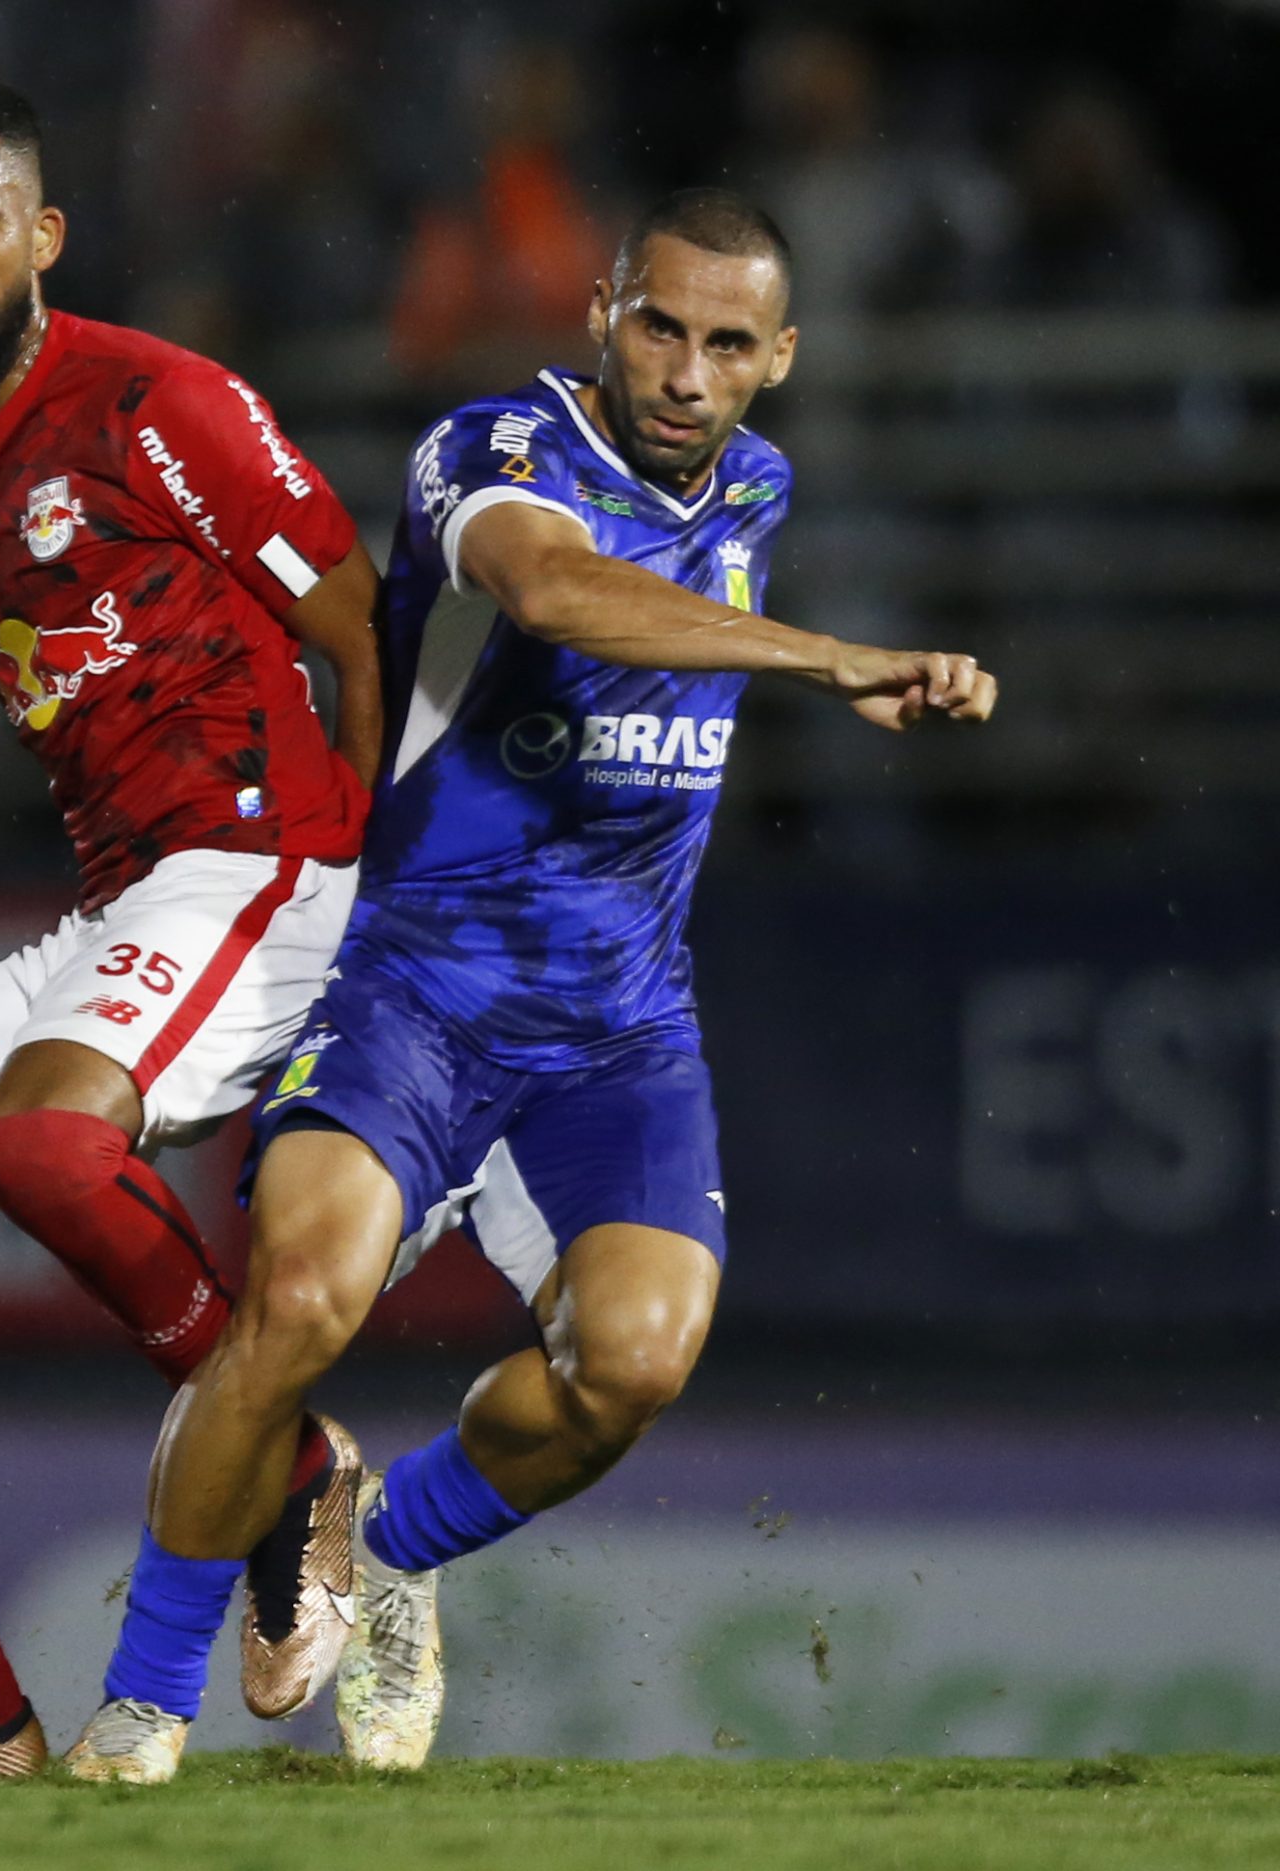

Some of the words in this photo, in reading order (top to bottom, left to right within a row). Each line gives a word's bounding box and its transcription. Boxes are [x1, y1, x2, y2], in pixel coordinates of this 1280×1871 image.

[584, 766, 657, 788] Hospital
[659, 774, 671, 787] e
[95, 942, 183, 996] 35
